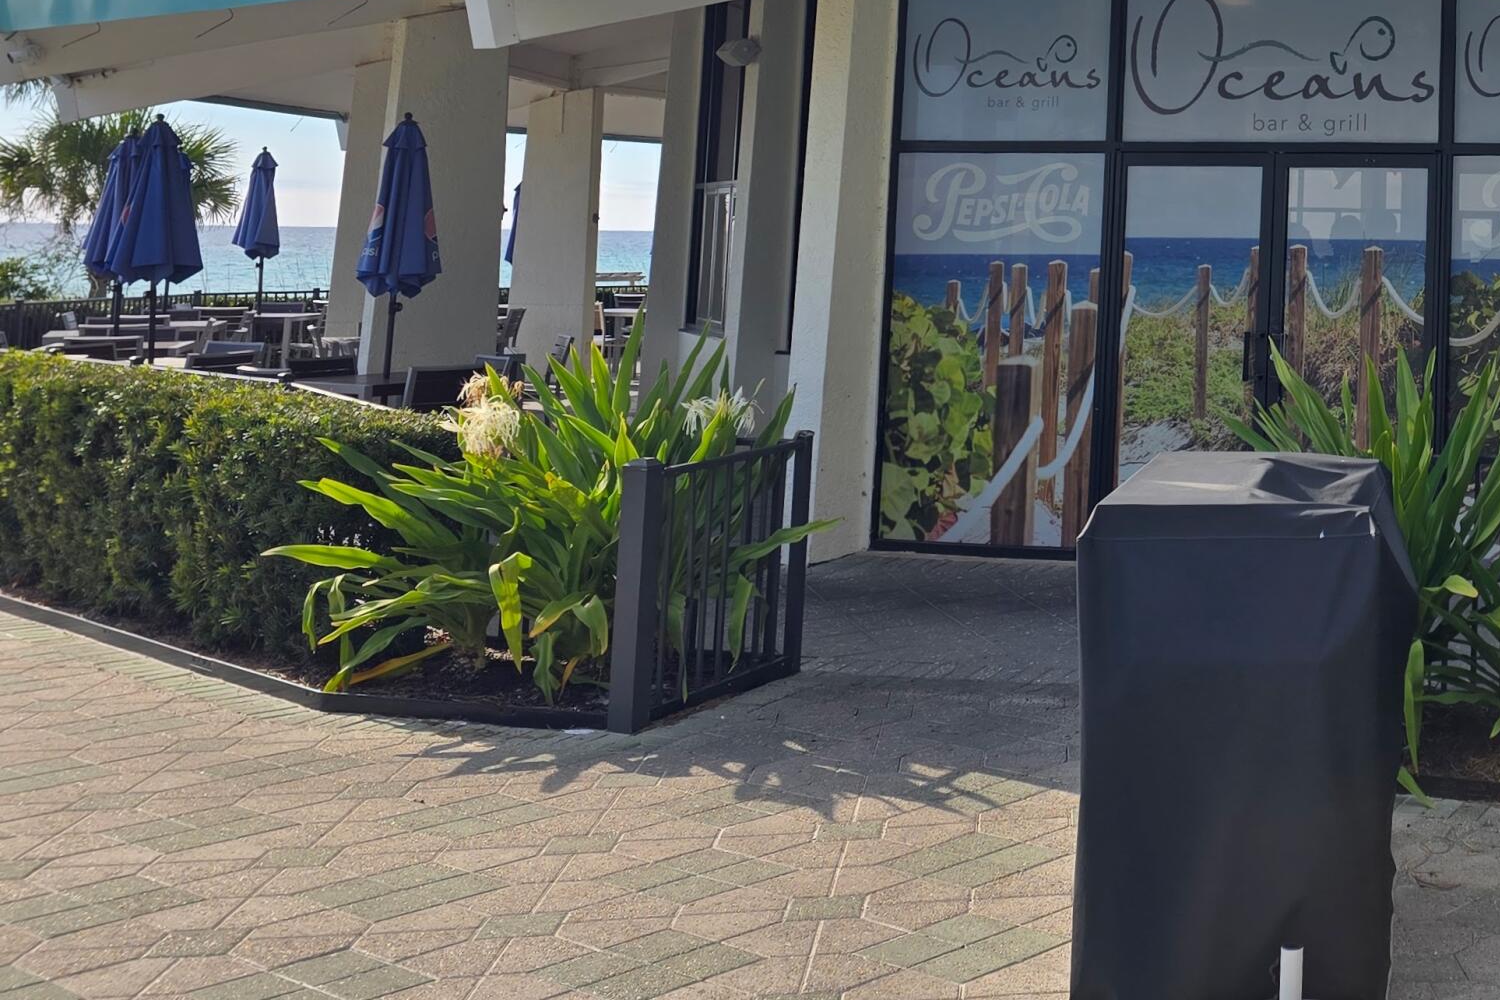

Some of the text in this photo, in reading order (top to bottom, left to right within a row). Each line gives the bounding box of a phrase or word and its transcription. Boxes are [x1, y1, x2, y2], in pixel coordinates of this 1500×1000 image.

[913, 18, 1101, 97] Oceans
[987, 97, 1060, 111] bar & grill
[1252, 113, 1367, 136] bar & grill
